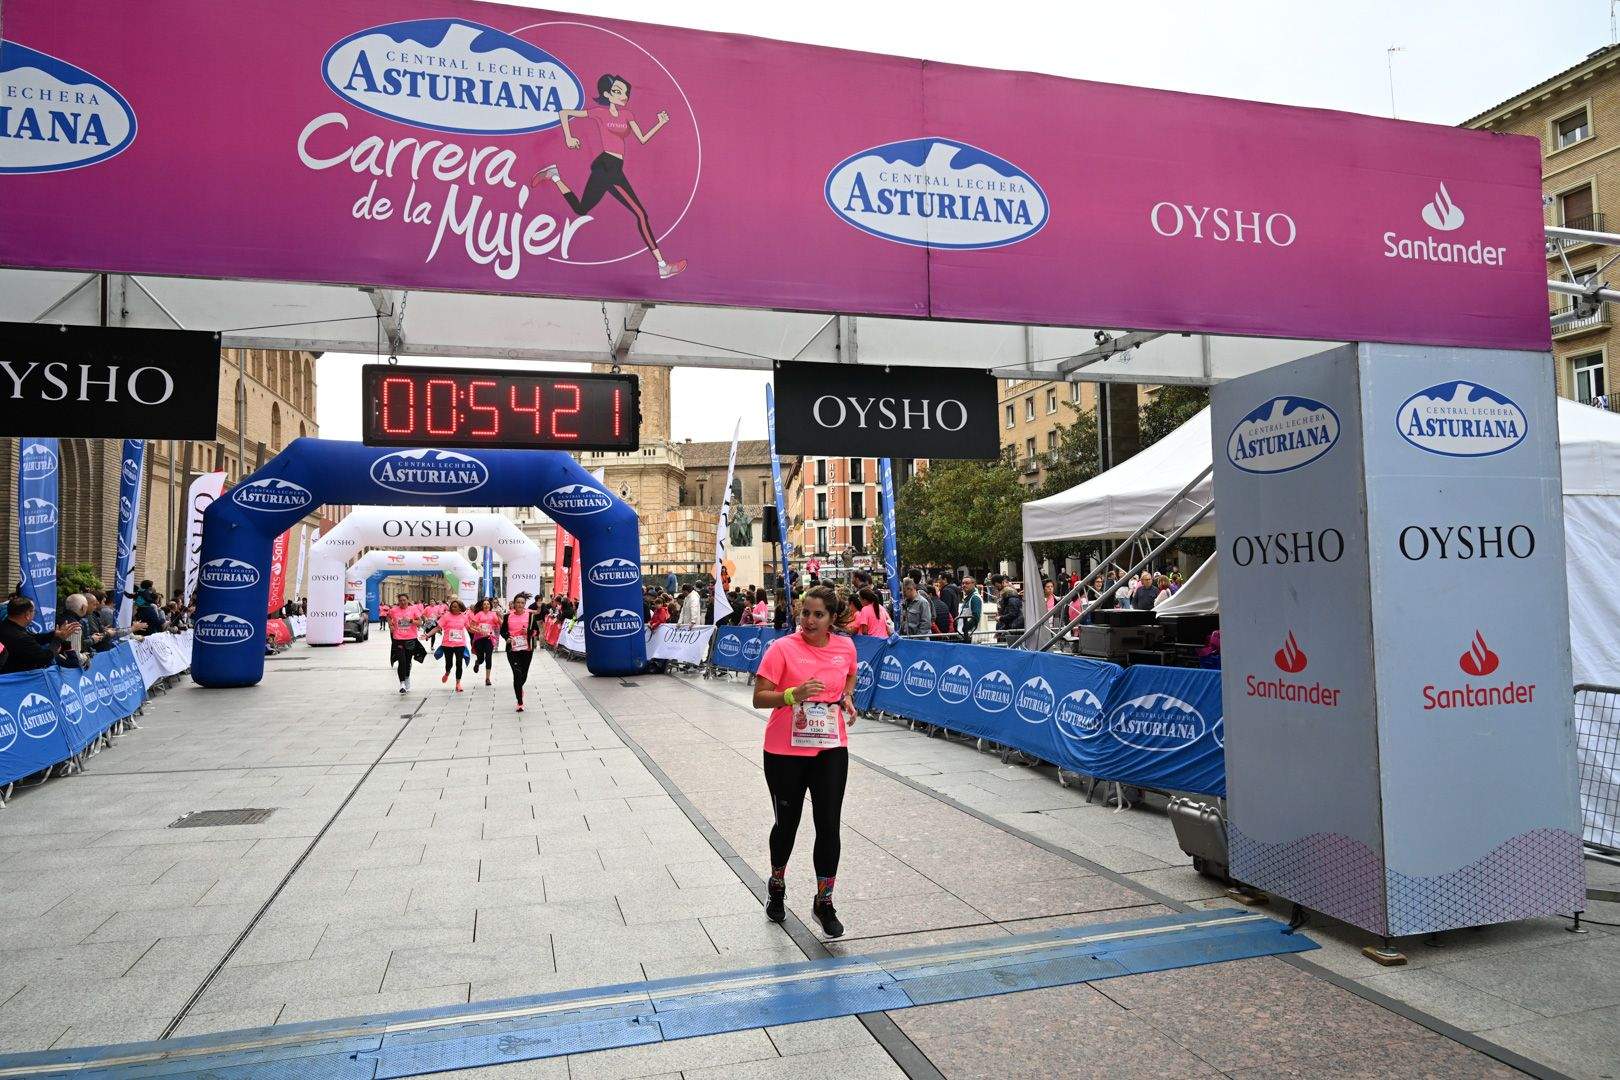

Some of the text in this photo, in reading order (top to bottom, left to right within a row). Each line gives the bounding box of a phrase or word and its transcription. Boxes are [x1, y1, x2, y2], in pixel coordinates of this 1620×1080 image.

[386, 50, 558, 81] CENTRAL LECHERA
[343, 49, 563, 113] ASTURIANA
[7, 86, 99, 105] ECHERA
[297, 112, 517, 187] Carrera
[879, 171, 1026, 193] CENTRAL LECHERA
[352, 180, 432, 225] de la
[844, 171, 1033, 225] ASTURIANA
[425, 184, 594, 280] Mujer
[1151, 201, 1297, 247] OYSHO
[1383, 231, 1507, 267] Santander
[0, 360, 174, 405] YSHO
[812, 394, 969, 432] OYSHO
[1407, 408, 1519, 439] ASTURIANA
[1426, 406, 1514, 416] CENTRAL LECHERA
[1248, 413, 1326, 437] CENTRAL LECHERA
[1233, 424, 1331, 461] ASTURIANA
[379, 461, 480, 484] ASTURIANA
[237, 489, 305, 504] ASTURIANA
[550, 496, 608, 508] ASTURIANA
[382, 520, 474, 537] OYSHO
[1232, 528, 1345, 567] OYSHO
[1399, 524, 1536, 561] OYSHO
[201, 569, 255, 582] ASTURIANA
[592, 569, 638, 580] ASTURIANA
[195, 624, 249, 637] ASTURIANA
[593, 620, 640, 631] ASTURIANA
[976, 683, 1010, 704] ASTURIANA
[1246, 675, 1340, 707] Santander
[1423, 682, 1536, 710] Santander
[22, 710, 57, 730] ASTURIANA
[808, 719, 826, 728] 016
[1113, 712, 1196, 739] ASTURIANA
